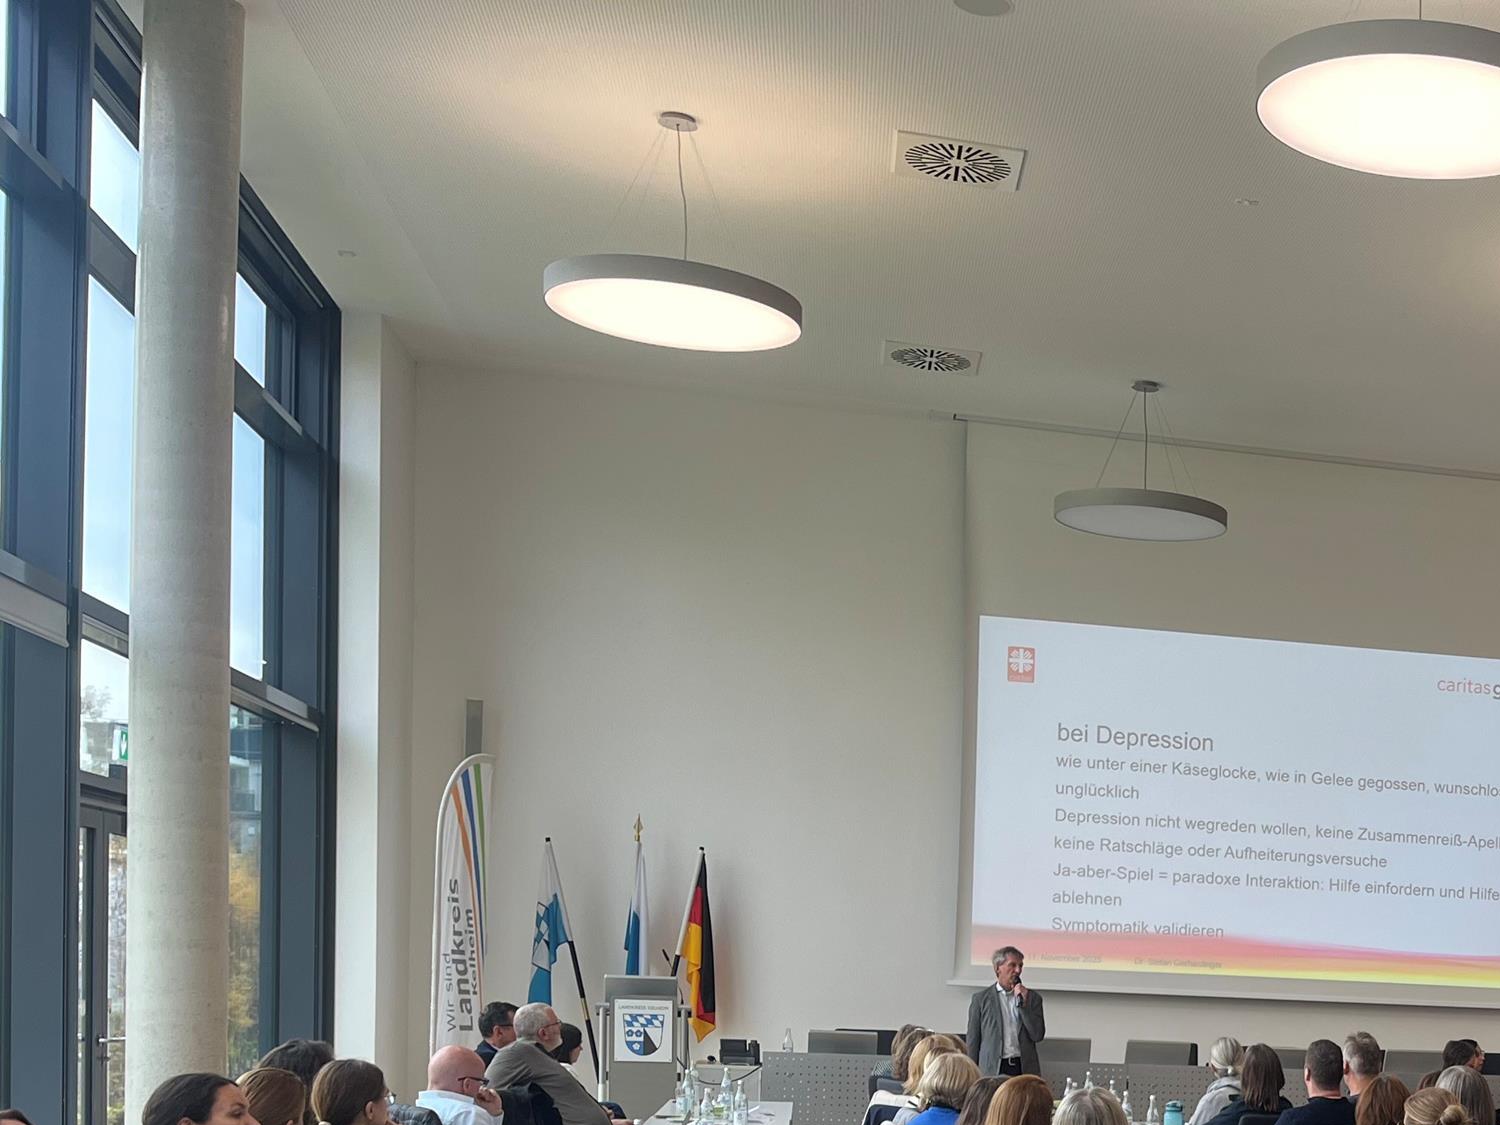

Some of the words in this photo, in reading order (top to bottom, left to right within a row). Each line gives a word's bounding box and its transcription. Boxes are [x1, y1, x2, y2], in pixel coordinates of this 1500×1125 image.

[1057, 722, 1089, 743] bei
[1096, 725, 1214, 751] Depression
[1055, 782, 1140, 800] unglücklich
[1056, 754, 1082, 769] wie
[1087, 757, 1126, 772] unter
[1129, 759, 1168, 775] einer
[1172, 761, 1261, 783] Käseglocke,
[1265, 770, 1290, 783] wie
[1294, 770, 1306, 784] in
[1311, 772, 1354, 787] Gelee
[1358, 776, 1430, 795] gegossen,
[1055, 808, 1141, 826] Depression
[1145, 812, 1181, 829] nicht
[1184, 816, 1256, 834] wegreden
[1261, 820, 1311, 839] wollen,
[1315, 824, 1354, 840] keine
[1053, 835, 1095, 851] keine
[1100, 838, 1183, 858] Ratschläge
[1187, 844, 1221, 858] oder
[1224, 845, 1388, 869] Aufheiterungsversuche
[1052, 890, 1122, 907] ablehnen
[1053, 863, 1154, 884] Ja-aber-Spiel
[1172, 870, 1241, 886] paradoxe
[1245, 873, 1324, 892] Interaktion:
[1329, 878, 1361, 893] Hilfe
[1365, 881, 1435, 897] einfordern
[1439, 885, 1465, 900] und
[1469, 886, 1500, 901] Hilfe
[1051, 917, 1150, 936] Symptomatik
[1153, 923, 1224, 938] validieren
[448, 878, 474, 1032] Landkreis
[465, 909, 478, 996] Kelheim
